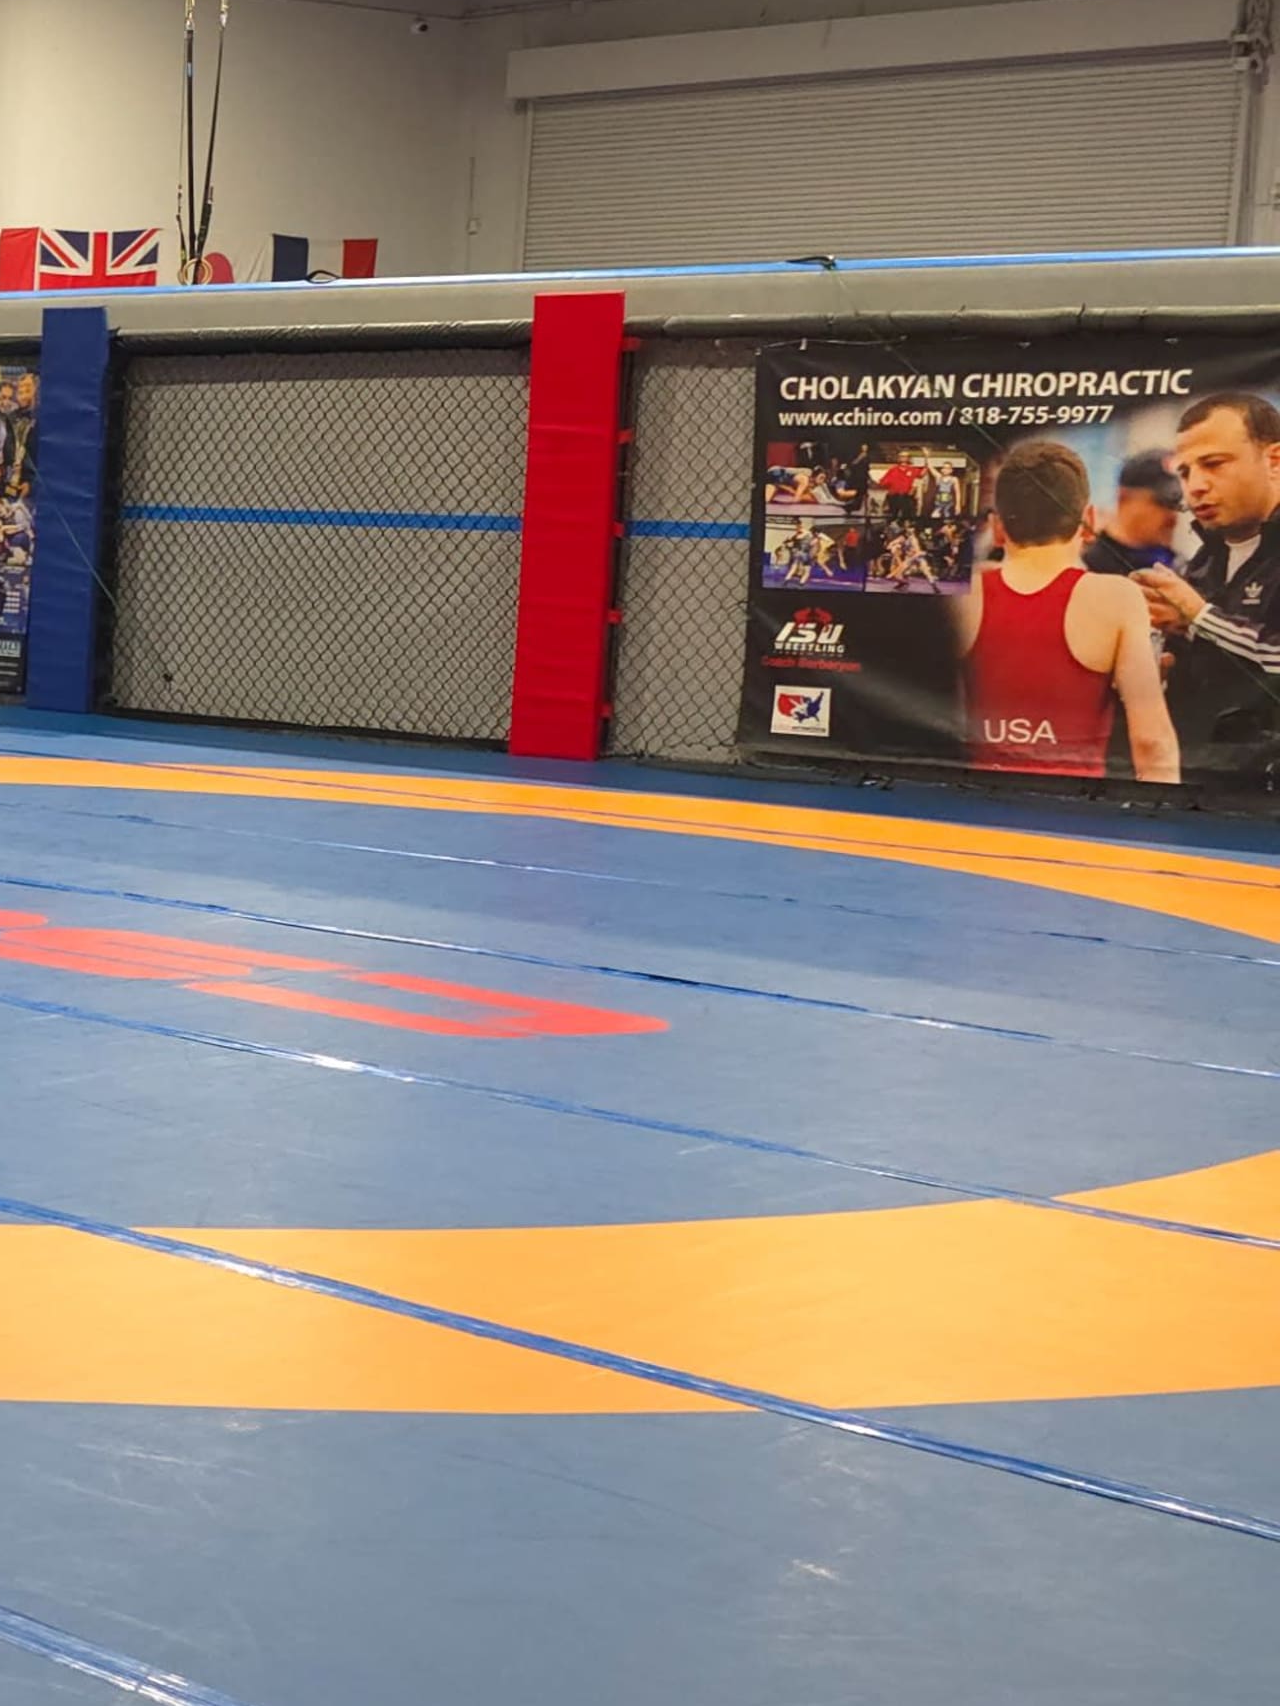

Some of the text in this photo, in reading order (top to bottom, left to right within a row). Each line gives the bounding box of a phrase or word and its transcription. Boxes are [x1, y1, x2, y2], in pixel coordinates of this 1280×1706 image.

[780, 368, 1192, 401] CHOLAKYAN CHIROPRACTIC
[778, 406, 942, 427] www.cchiro.com
[959, 404, 1114, 426] 818-755-9977
[775, 621, 845, 644] ISU
[773, 642, 846, 654] WRESTLING
[983, 718, 1058, 745] USA
